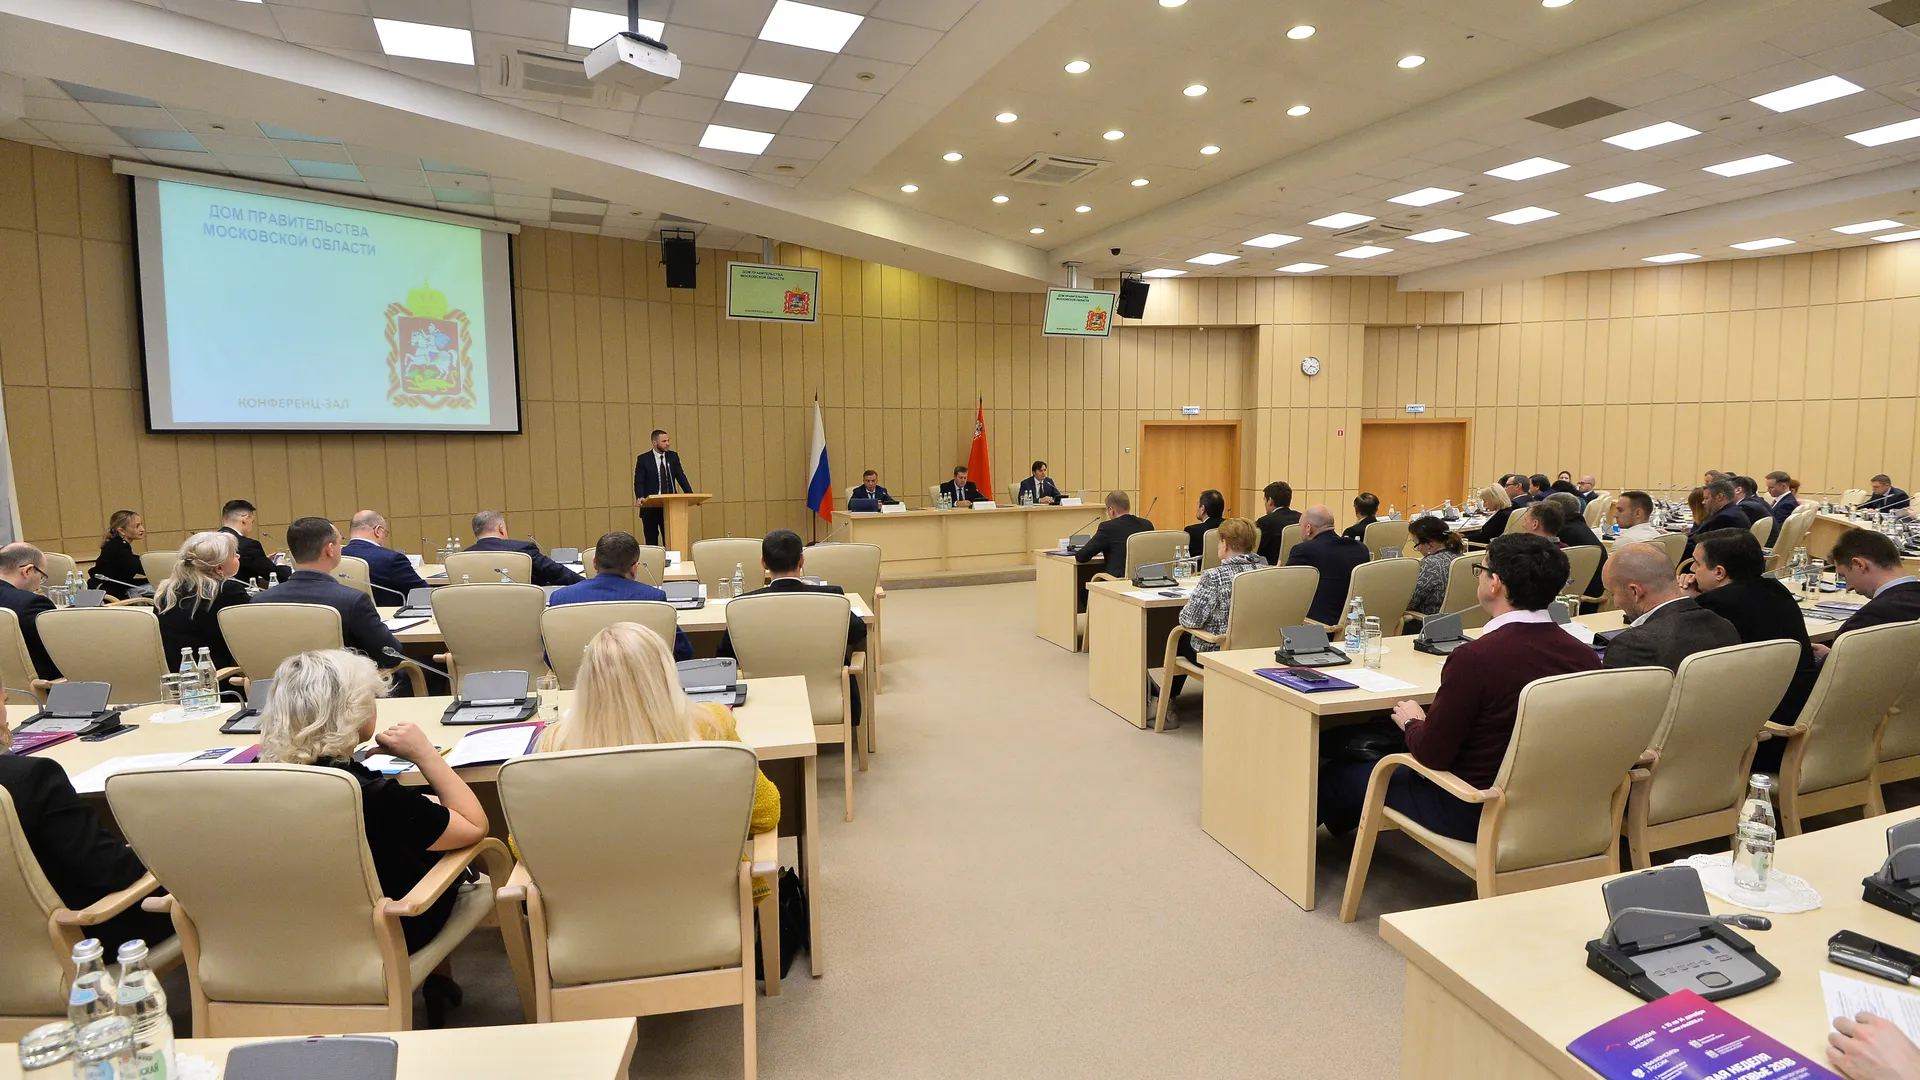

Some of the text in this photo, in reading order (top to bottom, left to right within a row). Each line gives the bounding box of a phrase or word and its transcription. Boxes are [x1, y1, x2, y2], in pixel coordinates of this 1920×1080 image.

[209, 204, 370, 238] ДОМ ПРАВИТЕЛЬСТВА
[203, 222, 377, 256] МОСКОВСКОЙ ОБЛАСТИ
[238, 398, 350, 411] КОНФЕРЕНЦ-ЗАЛ
[1726, 1052, 1773, 1075] НЕДЕЛЯ
[1733, 1066, 1774, 1080] ОВЬЕ
[1767, 1056, 1797, 1072] 2018
